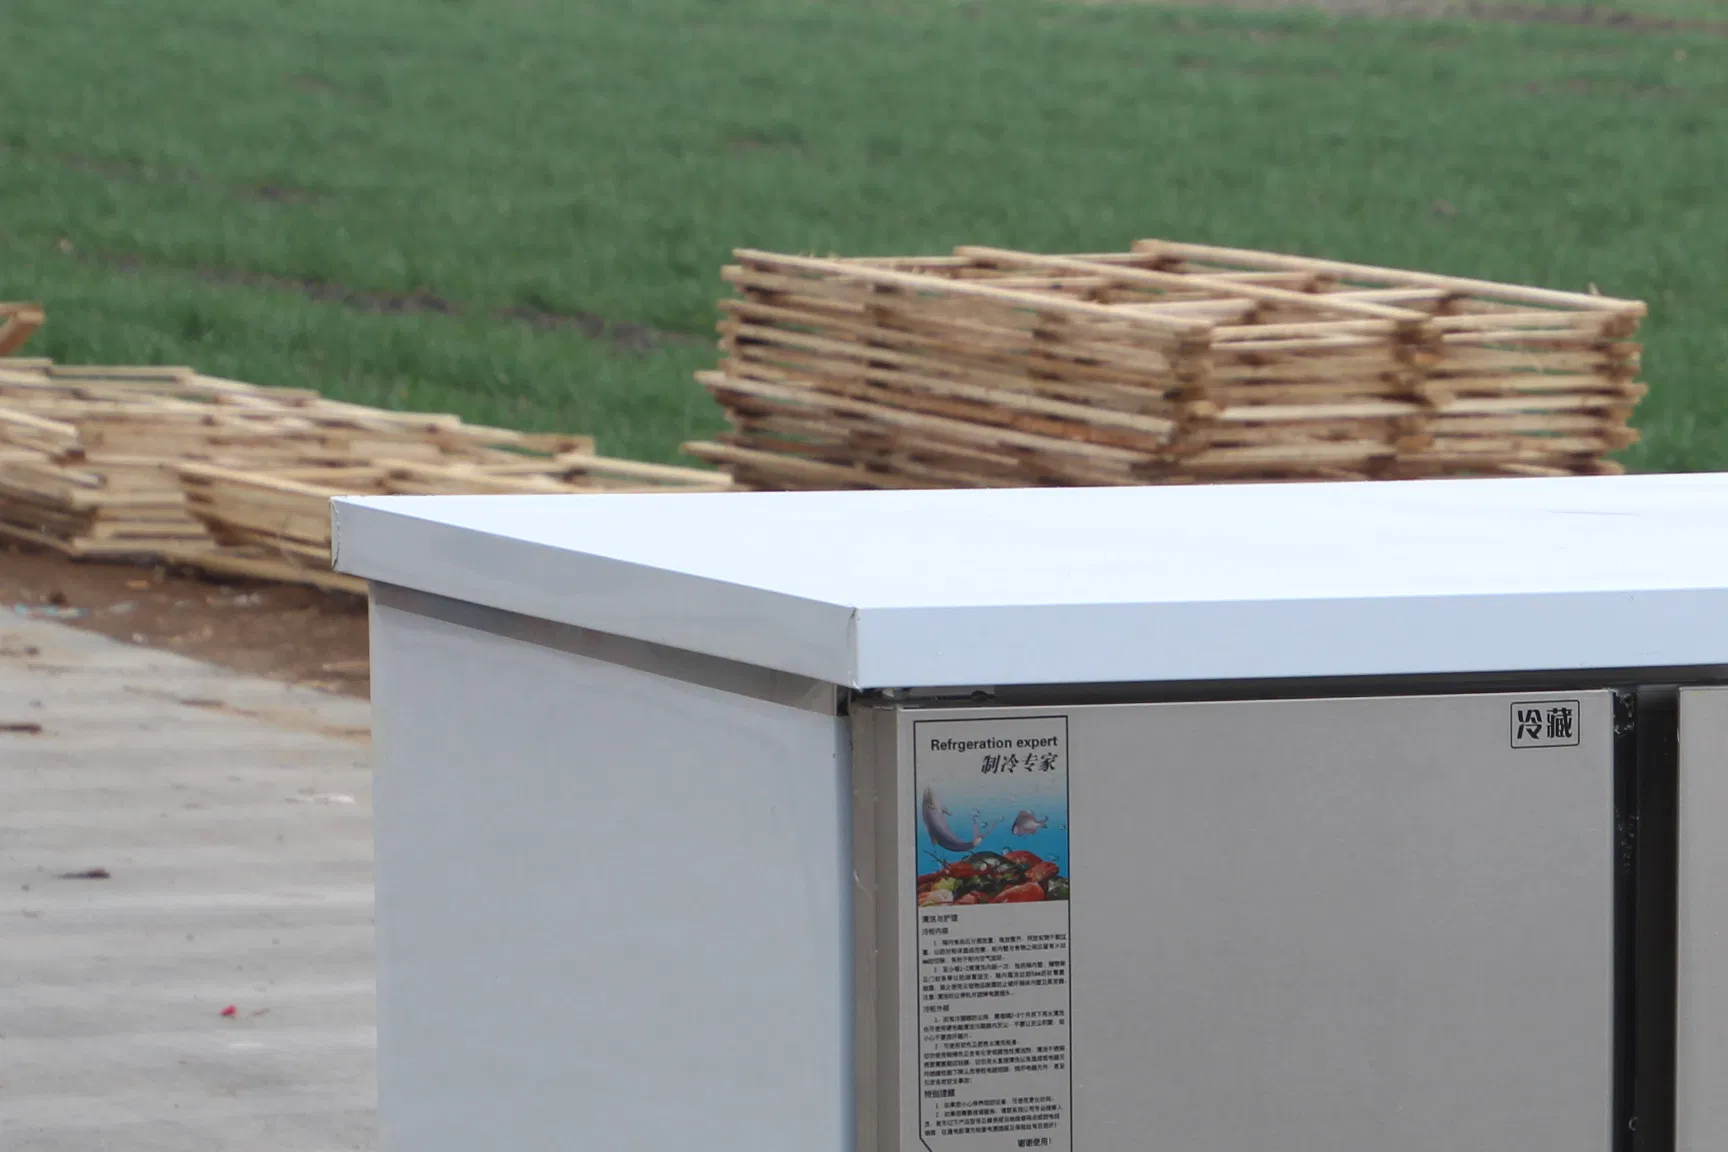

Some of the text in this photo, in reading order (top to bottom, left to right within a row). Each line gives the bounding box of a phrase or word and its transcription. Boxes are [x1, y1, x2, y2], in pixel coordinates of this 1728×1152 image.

[1517, 707, 1573, 740] 冷藏
[930, 736, 1058, 753] Refrgeration expert
[981, 752, 1058, 774] 制冷专家
